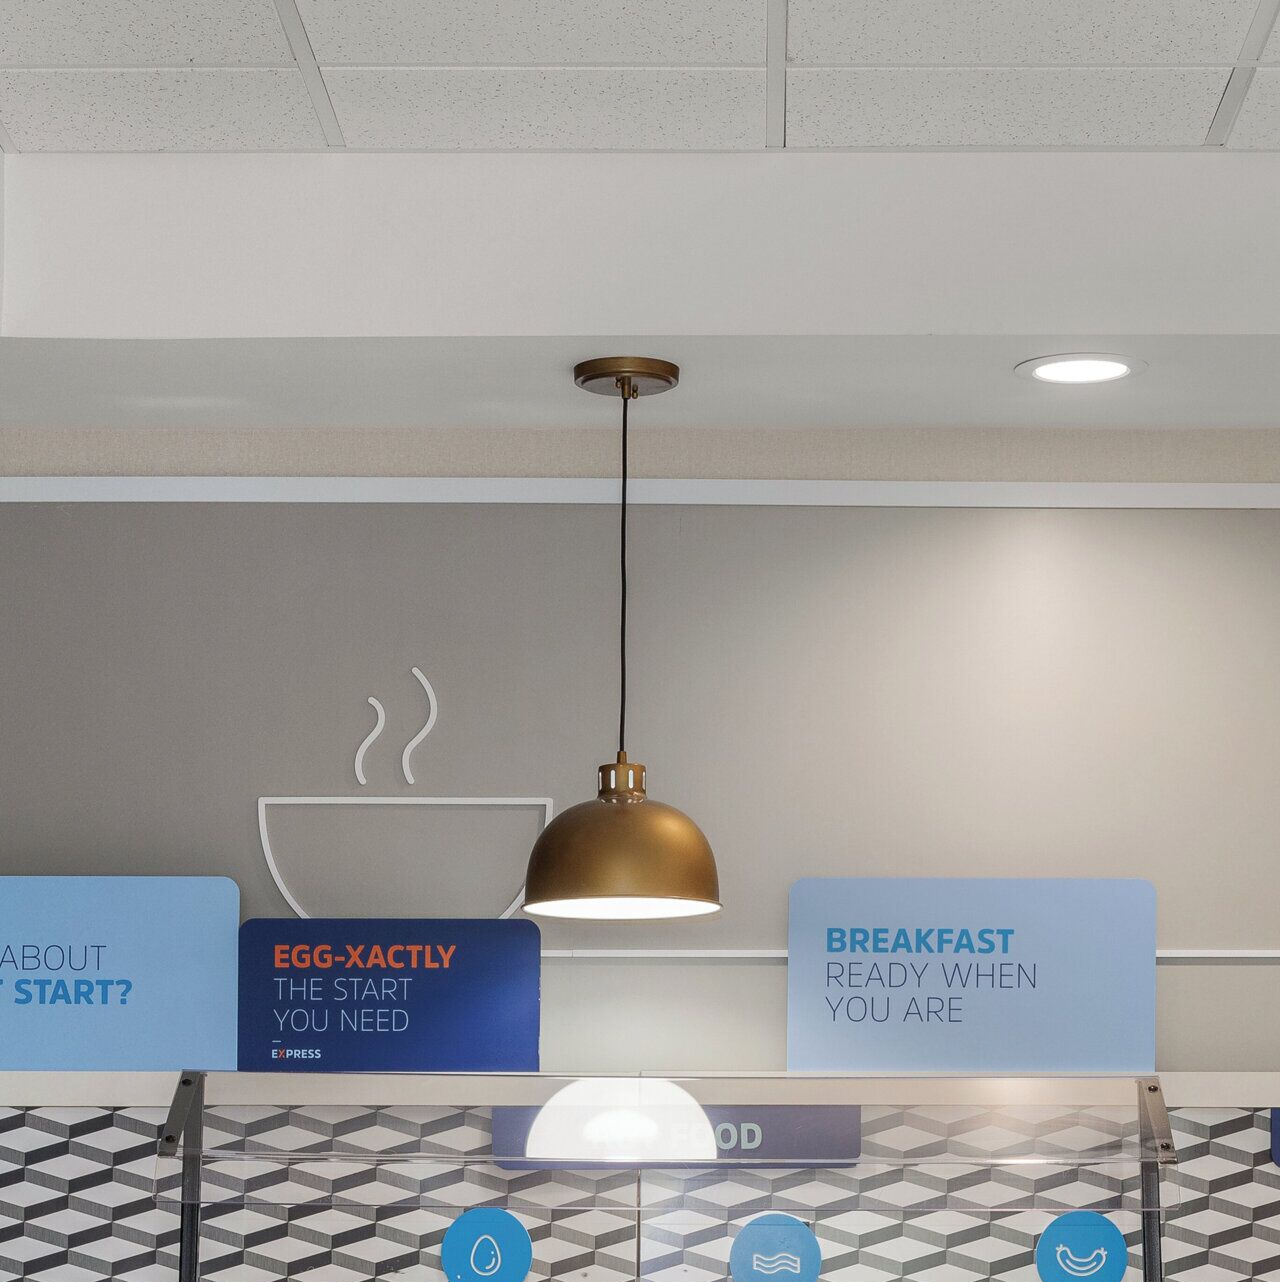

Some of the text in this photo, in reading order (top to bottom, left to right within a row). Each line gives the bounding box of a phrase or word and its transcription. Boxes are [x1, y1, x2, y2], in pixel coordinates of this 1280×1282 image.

[826, 927, 1015, 954] BREAKFAST
[273, 944, 457, 969] EGG-XACTLY
[826, 962, 1038, 989] READY WHEN
[14, 978, 133, 1005] START?
[273, 977, 413, 1001] THE START
[273, 1008, 409, 1032] YOU NEED
[825, 996, 963, 1023] YOU ARE
[271, 1049, 321, 1059] EXPRESS
